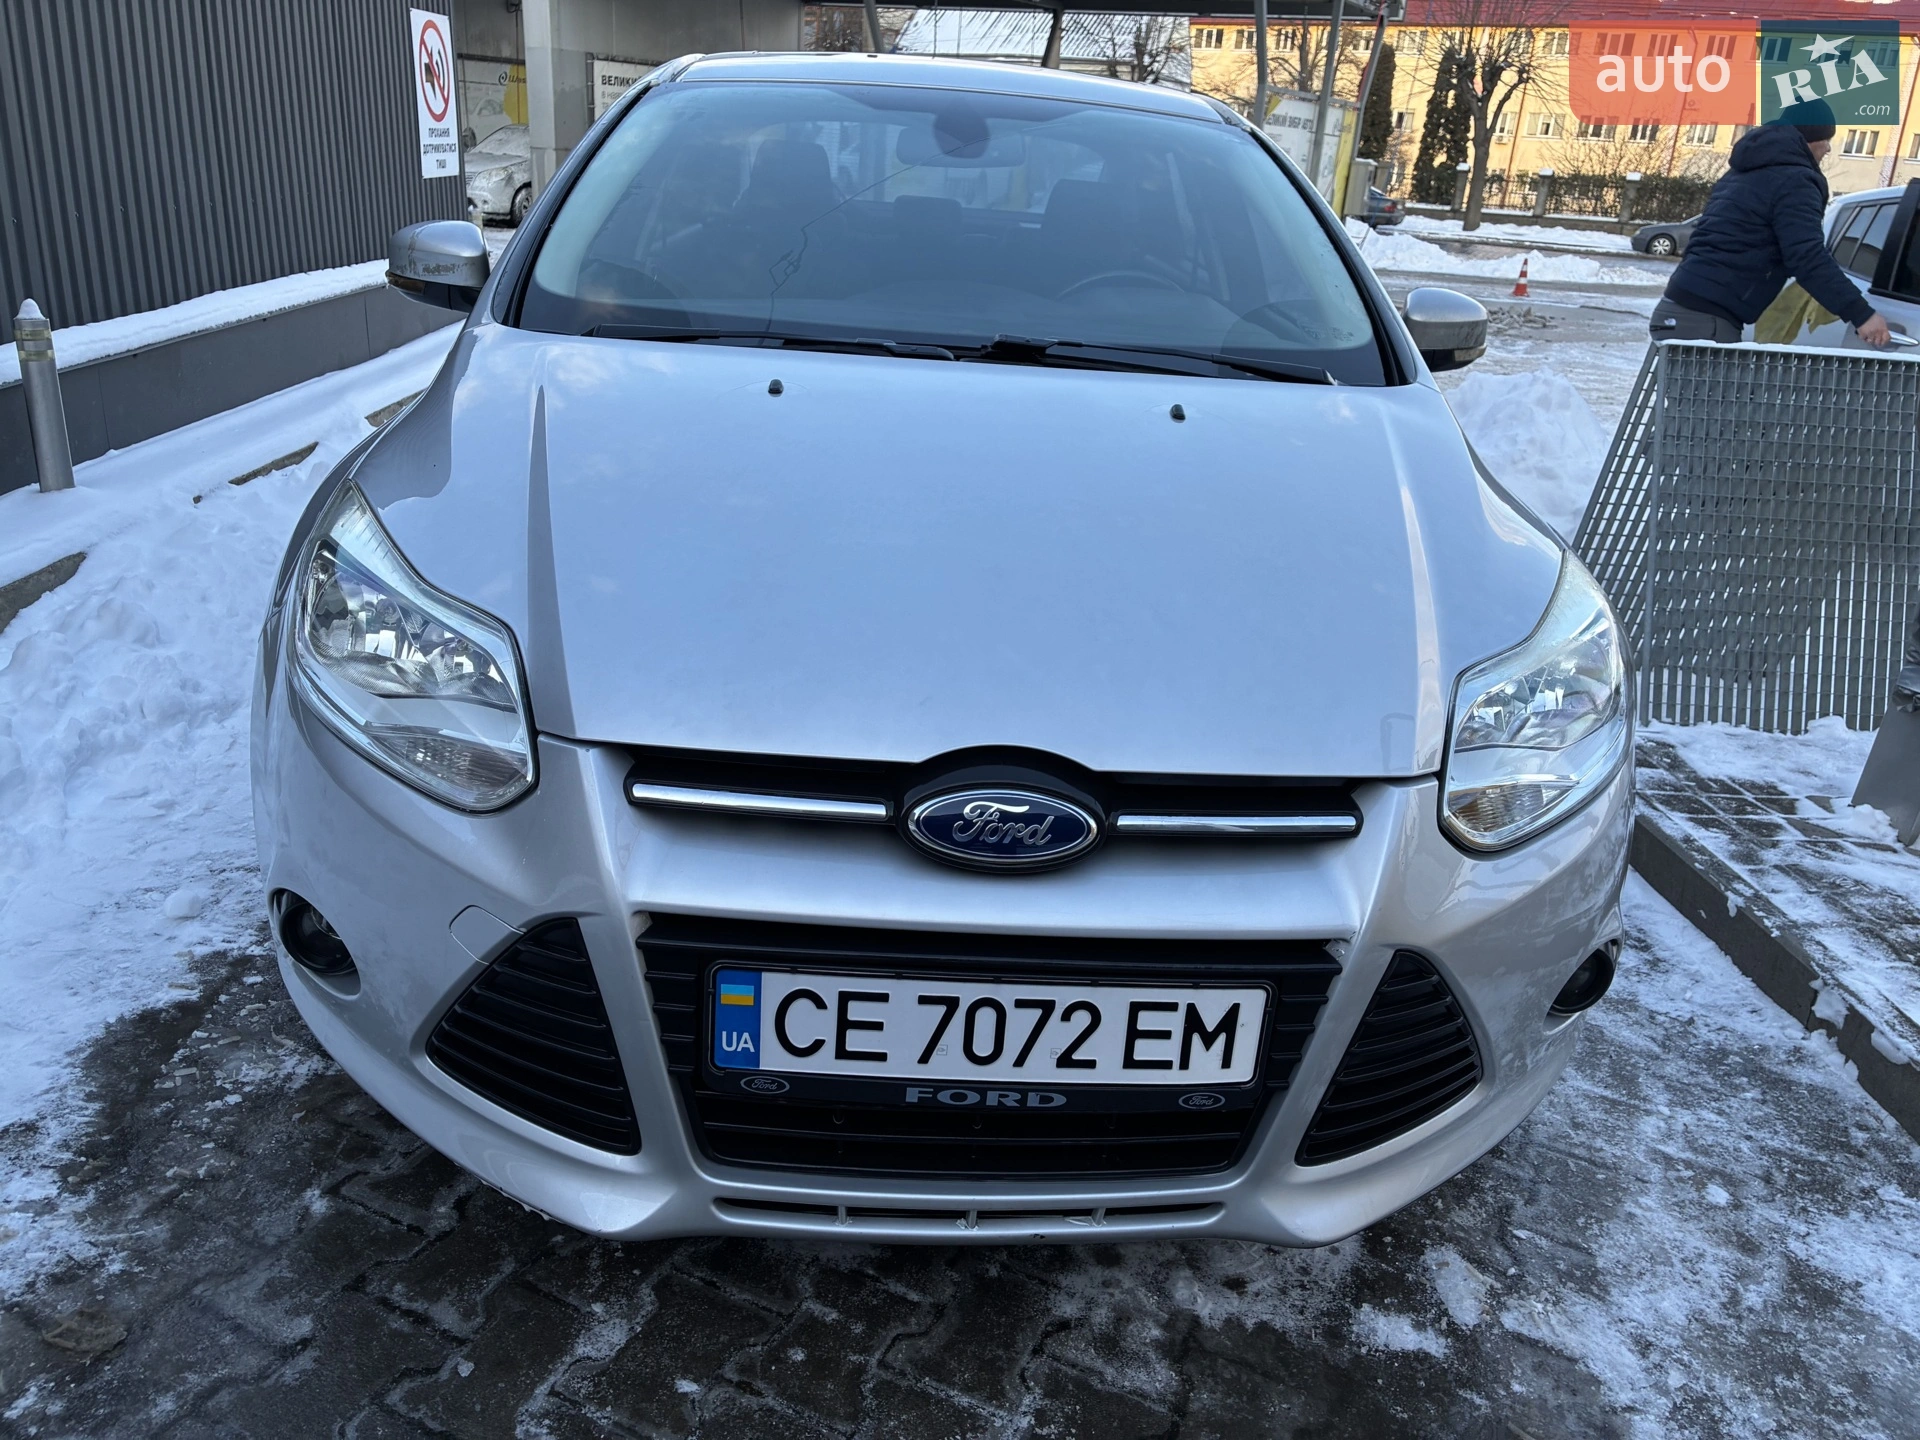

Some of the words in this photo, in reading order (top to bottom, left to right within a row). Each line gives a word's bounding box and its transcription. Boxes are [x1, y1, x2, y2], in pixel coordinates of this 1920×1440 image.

[601, 75, 641, 87] ВЕЛИКИ
[428, 127, 450, 138] ПРОХАННЯ
[423, 143, 457, 156] ДОТРИМУВАТИСЯ
[952, 801, 1055, 846] Ford
[774, 987, 890, 1062] CE
[916, 994, 1102, 1069] 7072
[1122, 1001, 1241, 1070] EM
[721, 1030, 755, 1053] UA
[751, 1078, 778, 1090] Ford
[905, 1087, 1067, 1108] FORD
[1188, 1095, 1214, 1105] Ford
